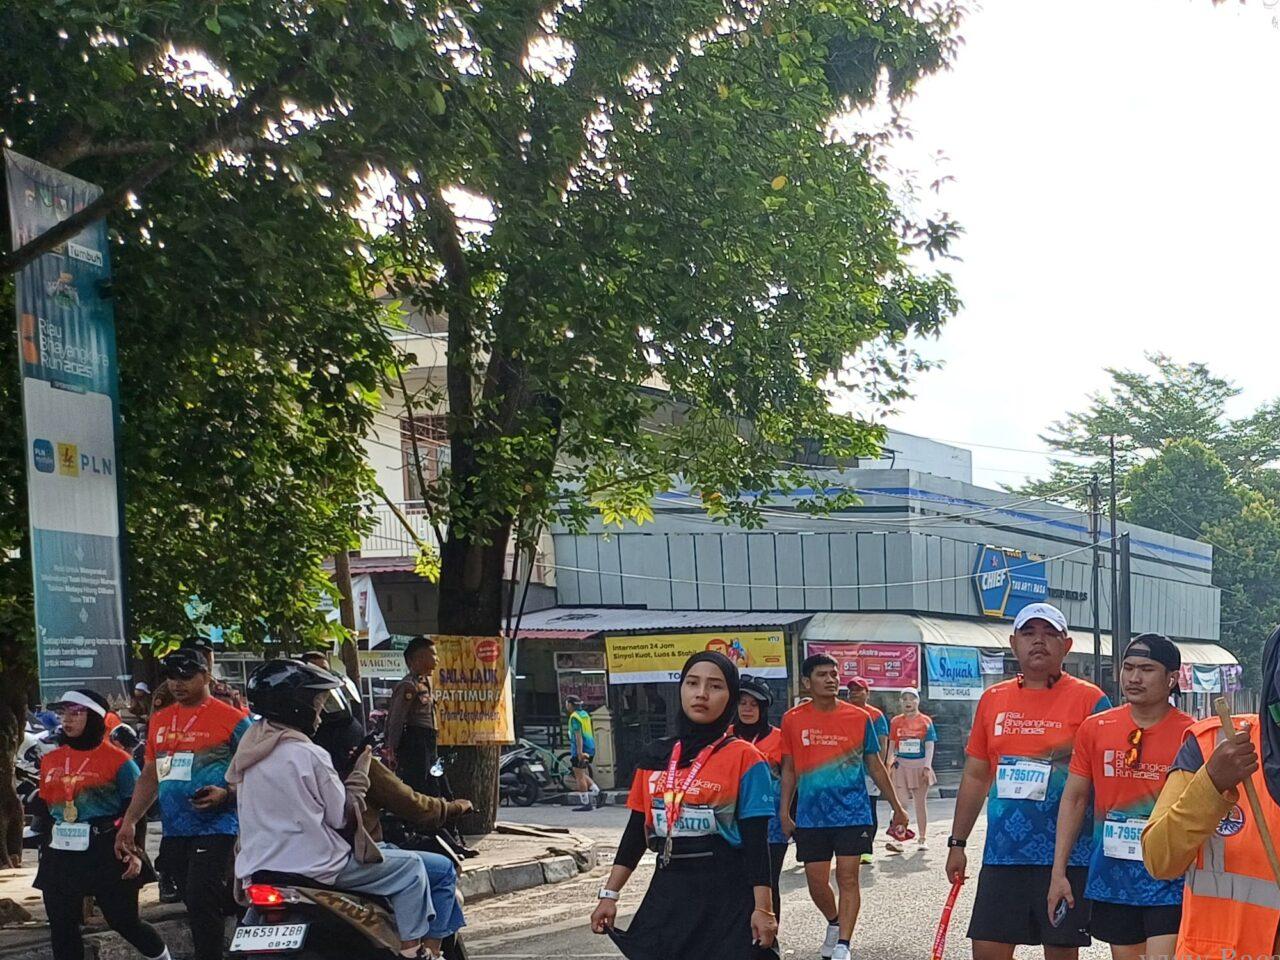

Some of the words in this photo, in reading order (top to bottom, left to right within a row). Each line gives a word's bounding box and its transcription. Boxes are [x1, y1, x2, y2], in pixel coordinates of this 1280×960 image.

[38, 318, 62, 338] Riau
[80, 454, 112, 475] PLN
[982, 570, 1006, 591] CHIEF
[613, 652, 634, 660] Sinyal
[360, 659, 401, 668] WARUNG
[435, 689, 500, 702] PATTIMURA
[998, 768, 1045, 784] M-7951771
[236, 928, 252, 939] BM
[252, 927, 279, 938] 6591
